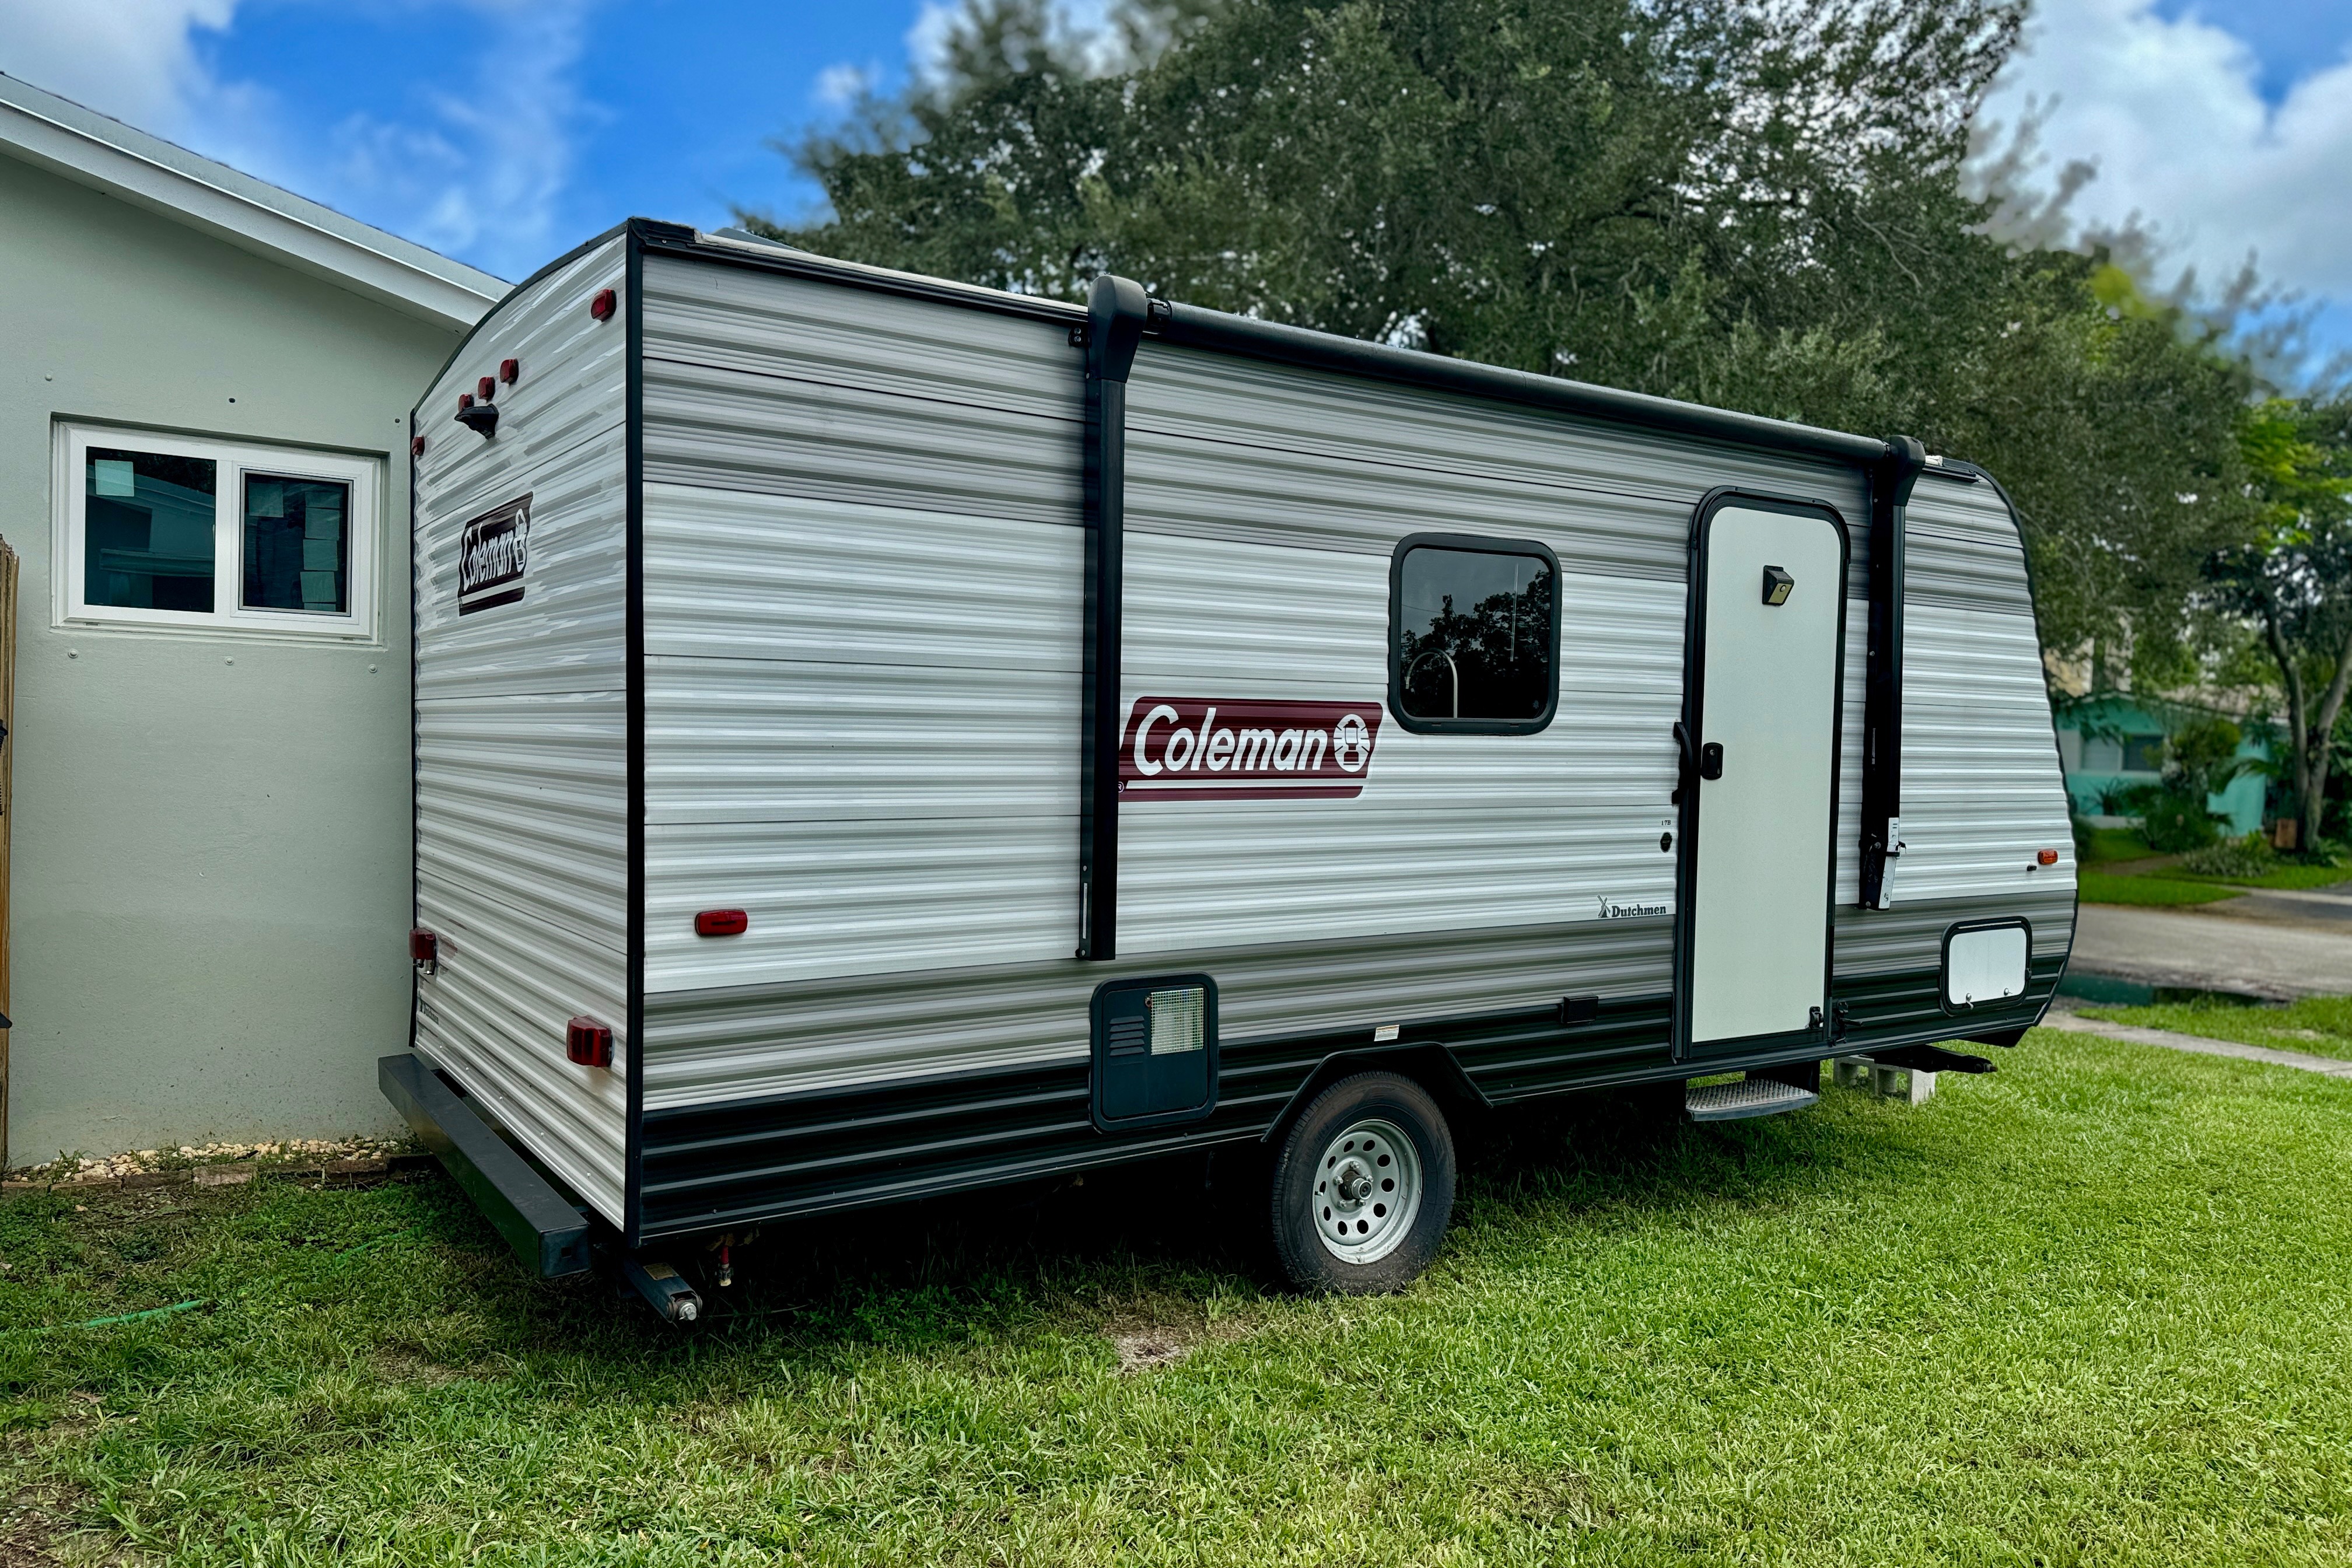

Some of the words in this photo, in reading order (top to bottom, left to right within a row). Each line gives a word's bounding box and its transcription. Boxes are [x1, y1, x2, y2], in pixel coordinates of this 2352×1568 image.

[461, 523, 514, 592] Coleman
[1134, 705, 1328, 776] Coleman
[1612, 904, 1667, 918] Dutchmen
